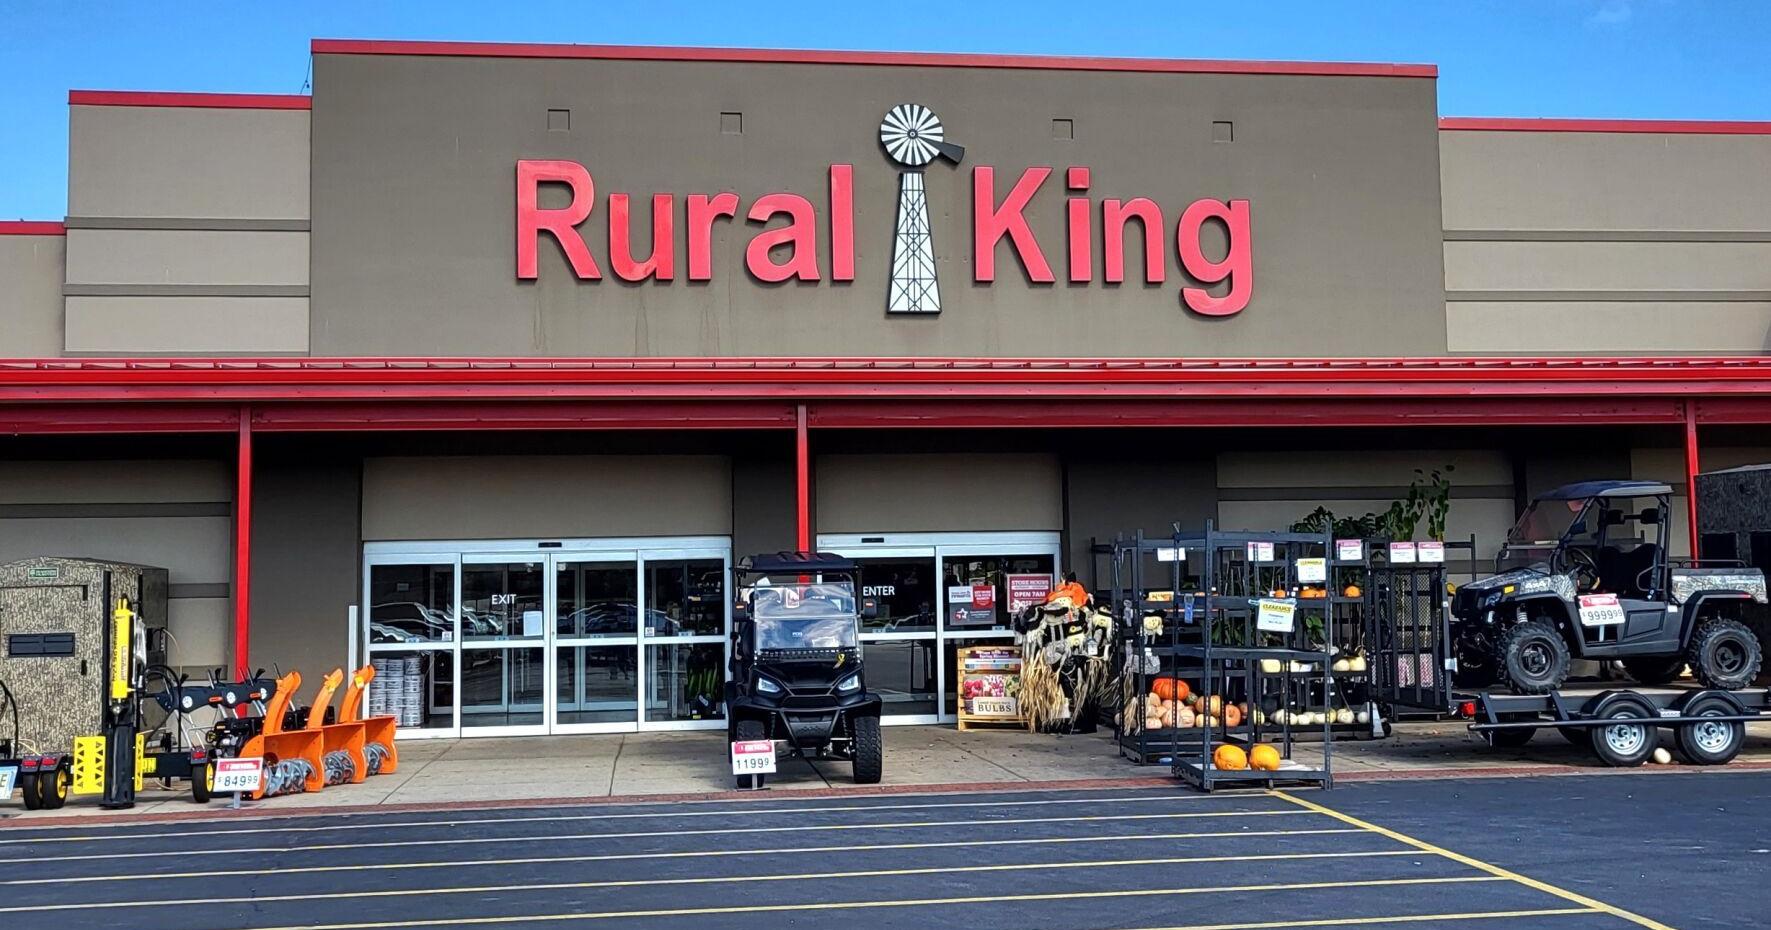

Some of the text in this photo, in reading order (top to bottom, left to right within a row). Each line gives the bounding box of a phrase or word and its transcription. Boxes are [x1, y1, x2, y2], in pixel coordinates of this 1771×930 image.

[516, 160, 1253, 316] Rural King
[863, 586, 895, 596] ENTER
[491, 594, 517, 605] EXIT
[978, 704, 1012, 712] BULBS
